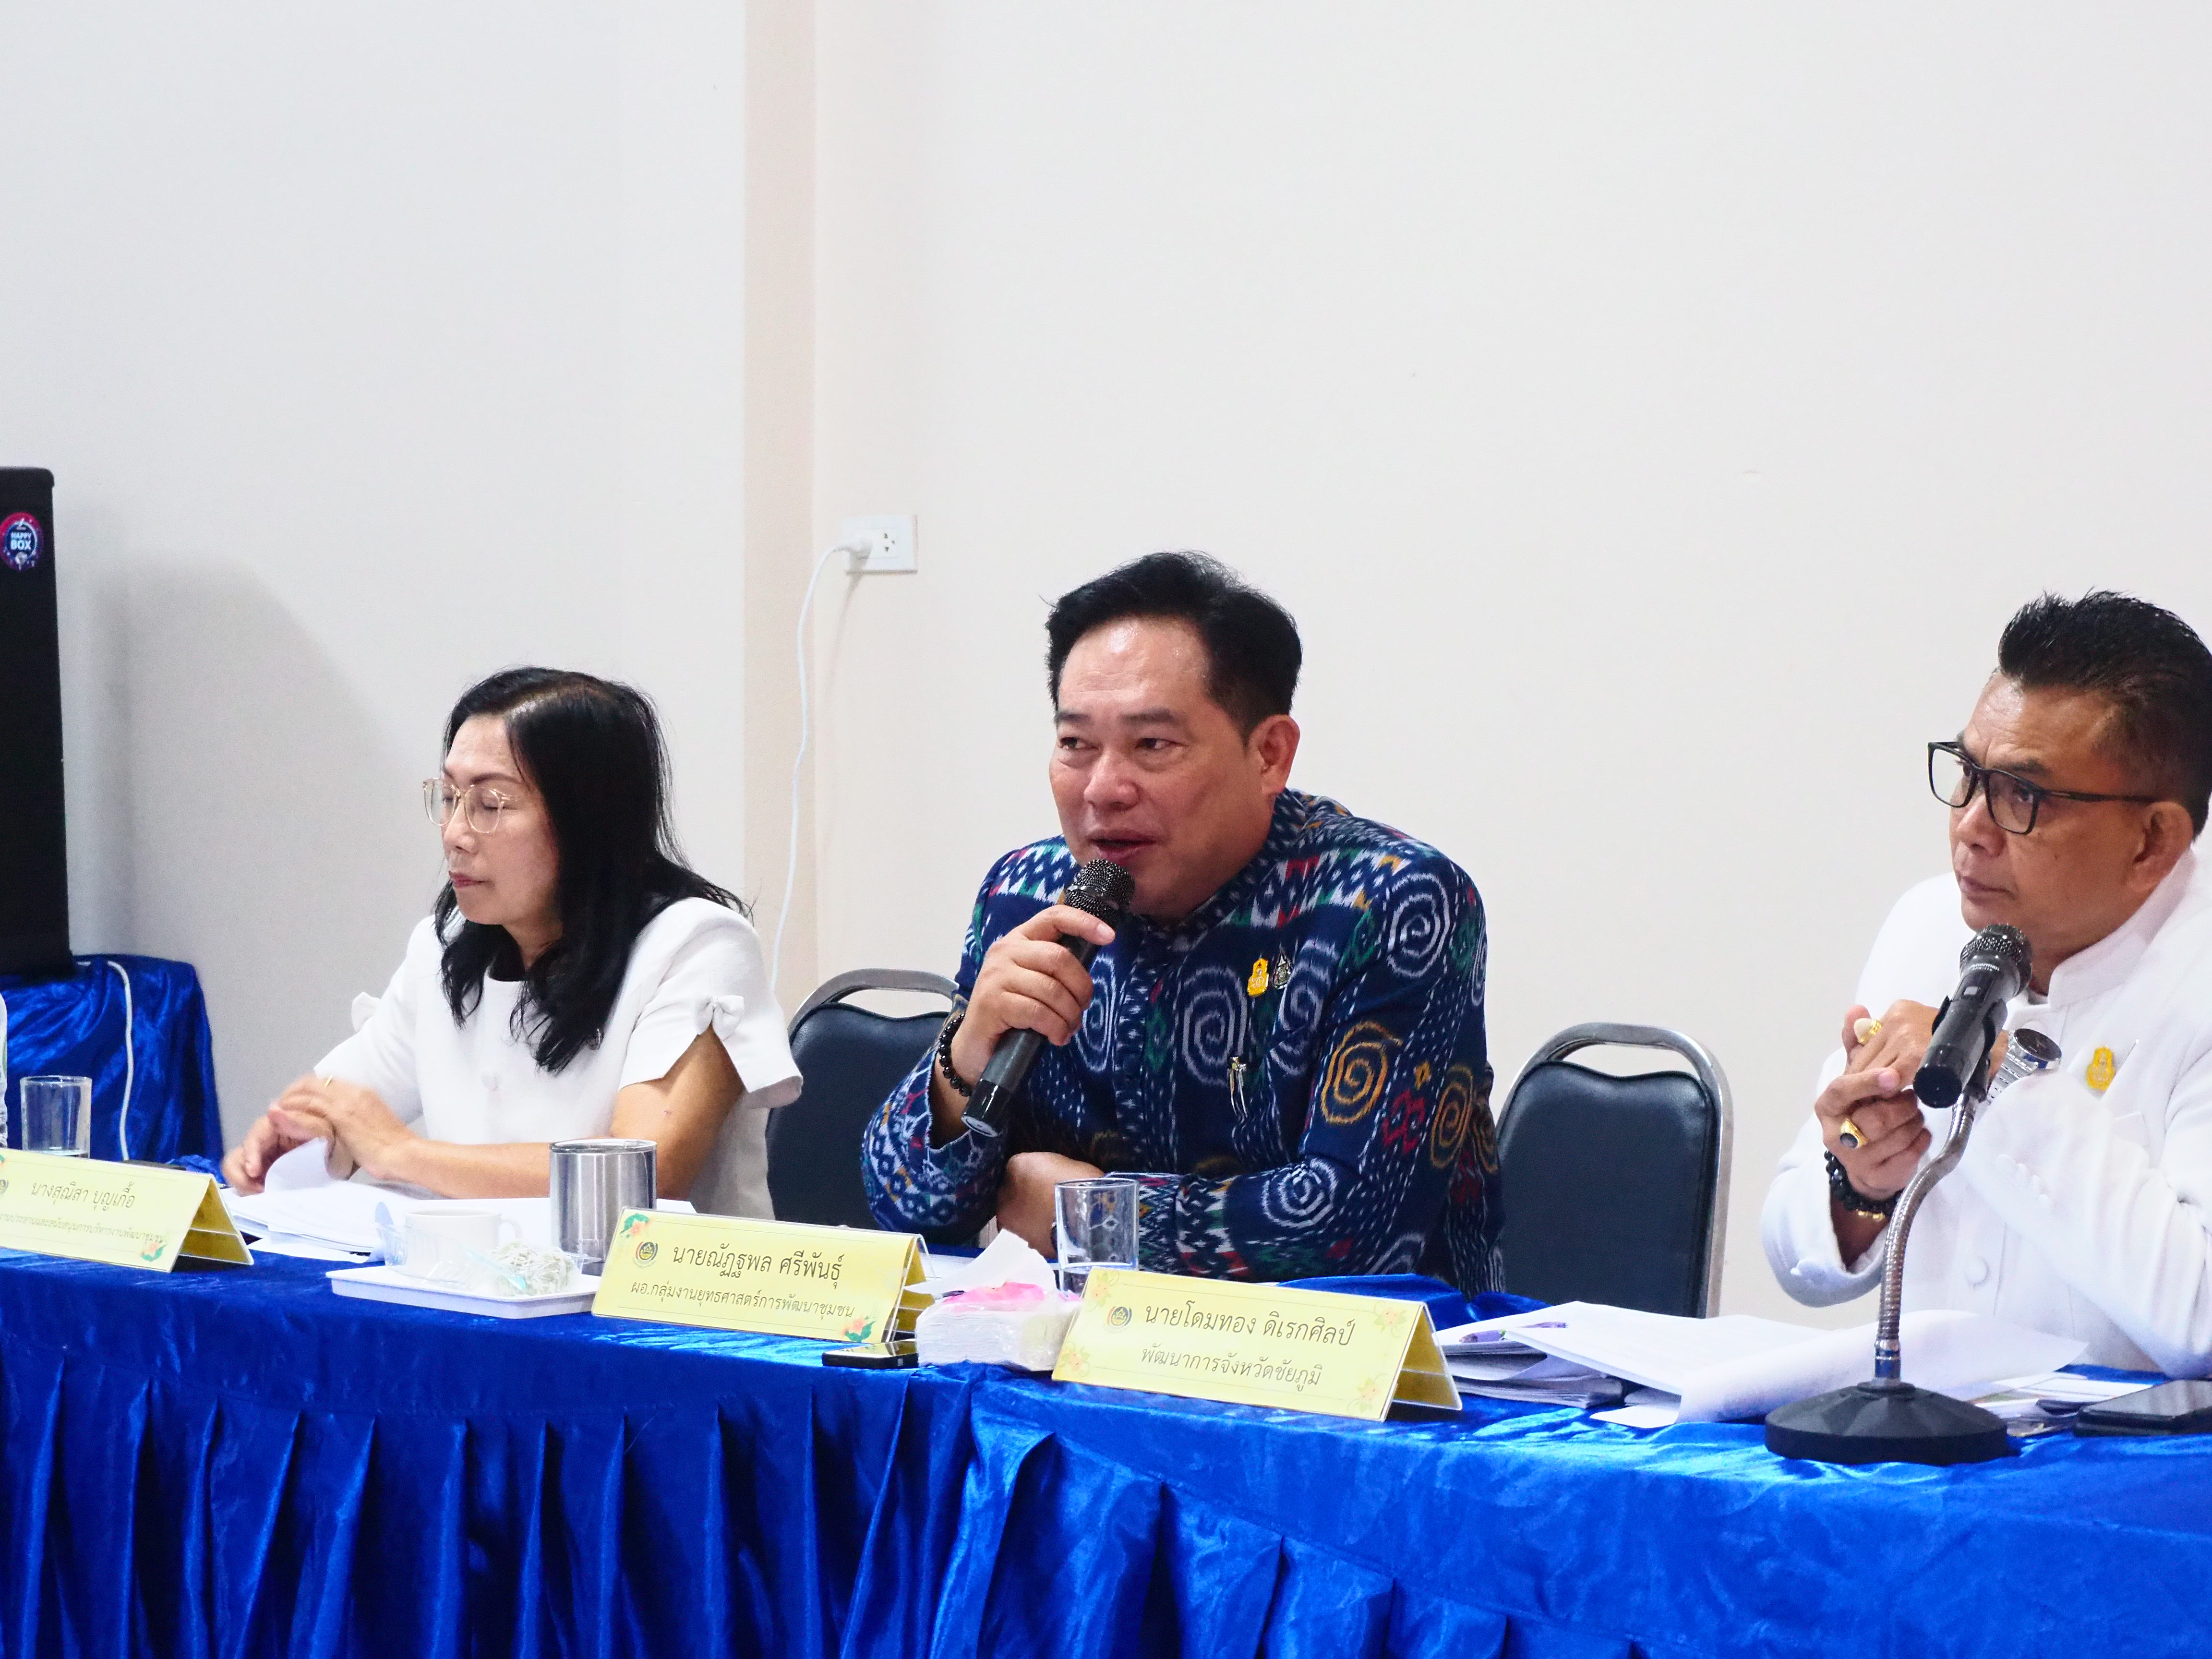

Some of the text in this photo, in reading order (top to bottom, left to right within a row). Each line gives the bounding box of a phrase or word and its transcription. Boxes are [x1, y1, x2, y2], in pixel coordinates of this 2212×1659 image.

[11, 532, 32, 540] HAPPY
[11, 540, 32, 550] BOX
[31, 1181, 89, 1205] นางสุณิสา
[673, 1243, 845, 1289] นายณัฏฐพล ศรีพันธุ์
[631, 1281, 855, 1320] ผอ.กลุ่มงานยุทธศาสตร์การพัฒนาชุมชน
[1145, 1300, 1356, 1346] นายโดมทอง ดิเรกศิลป์
[1142, 1343, 1323, 1392] พัฒนาการจังหวัดชัยภูมิ
